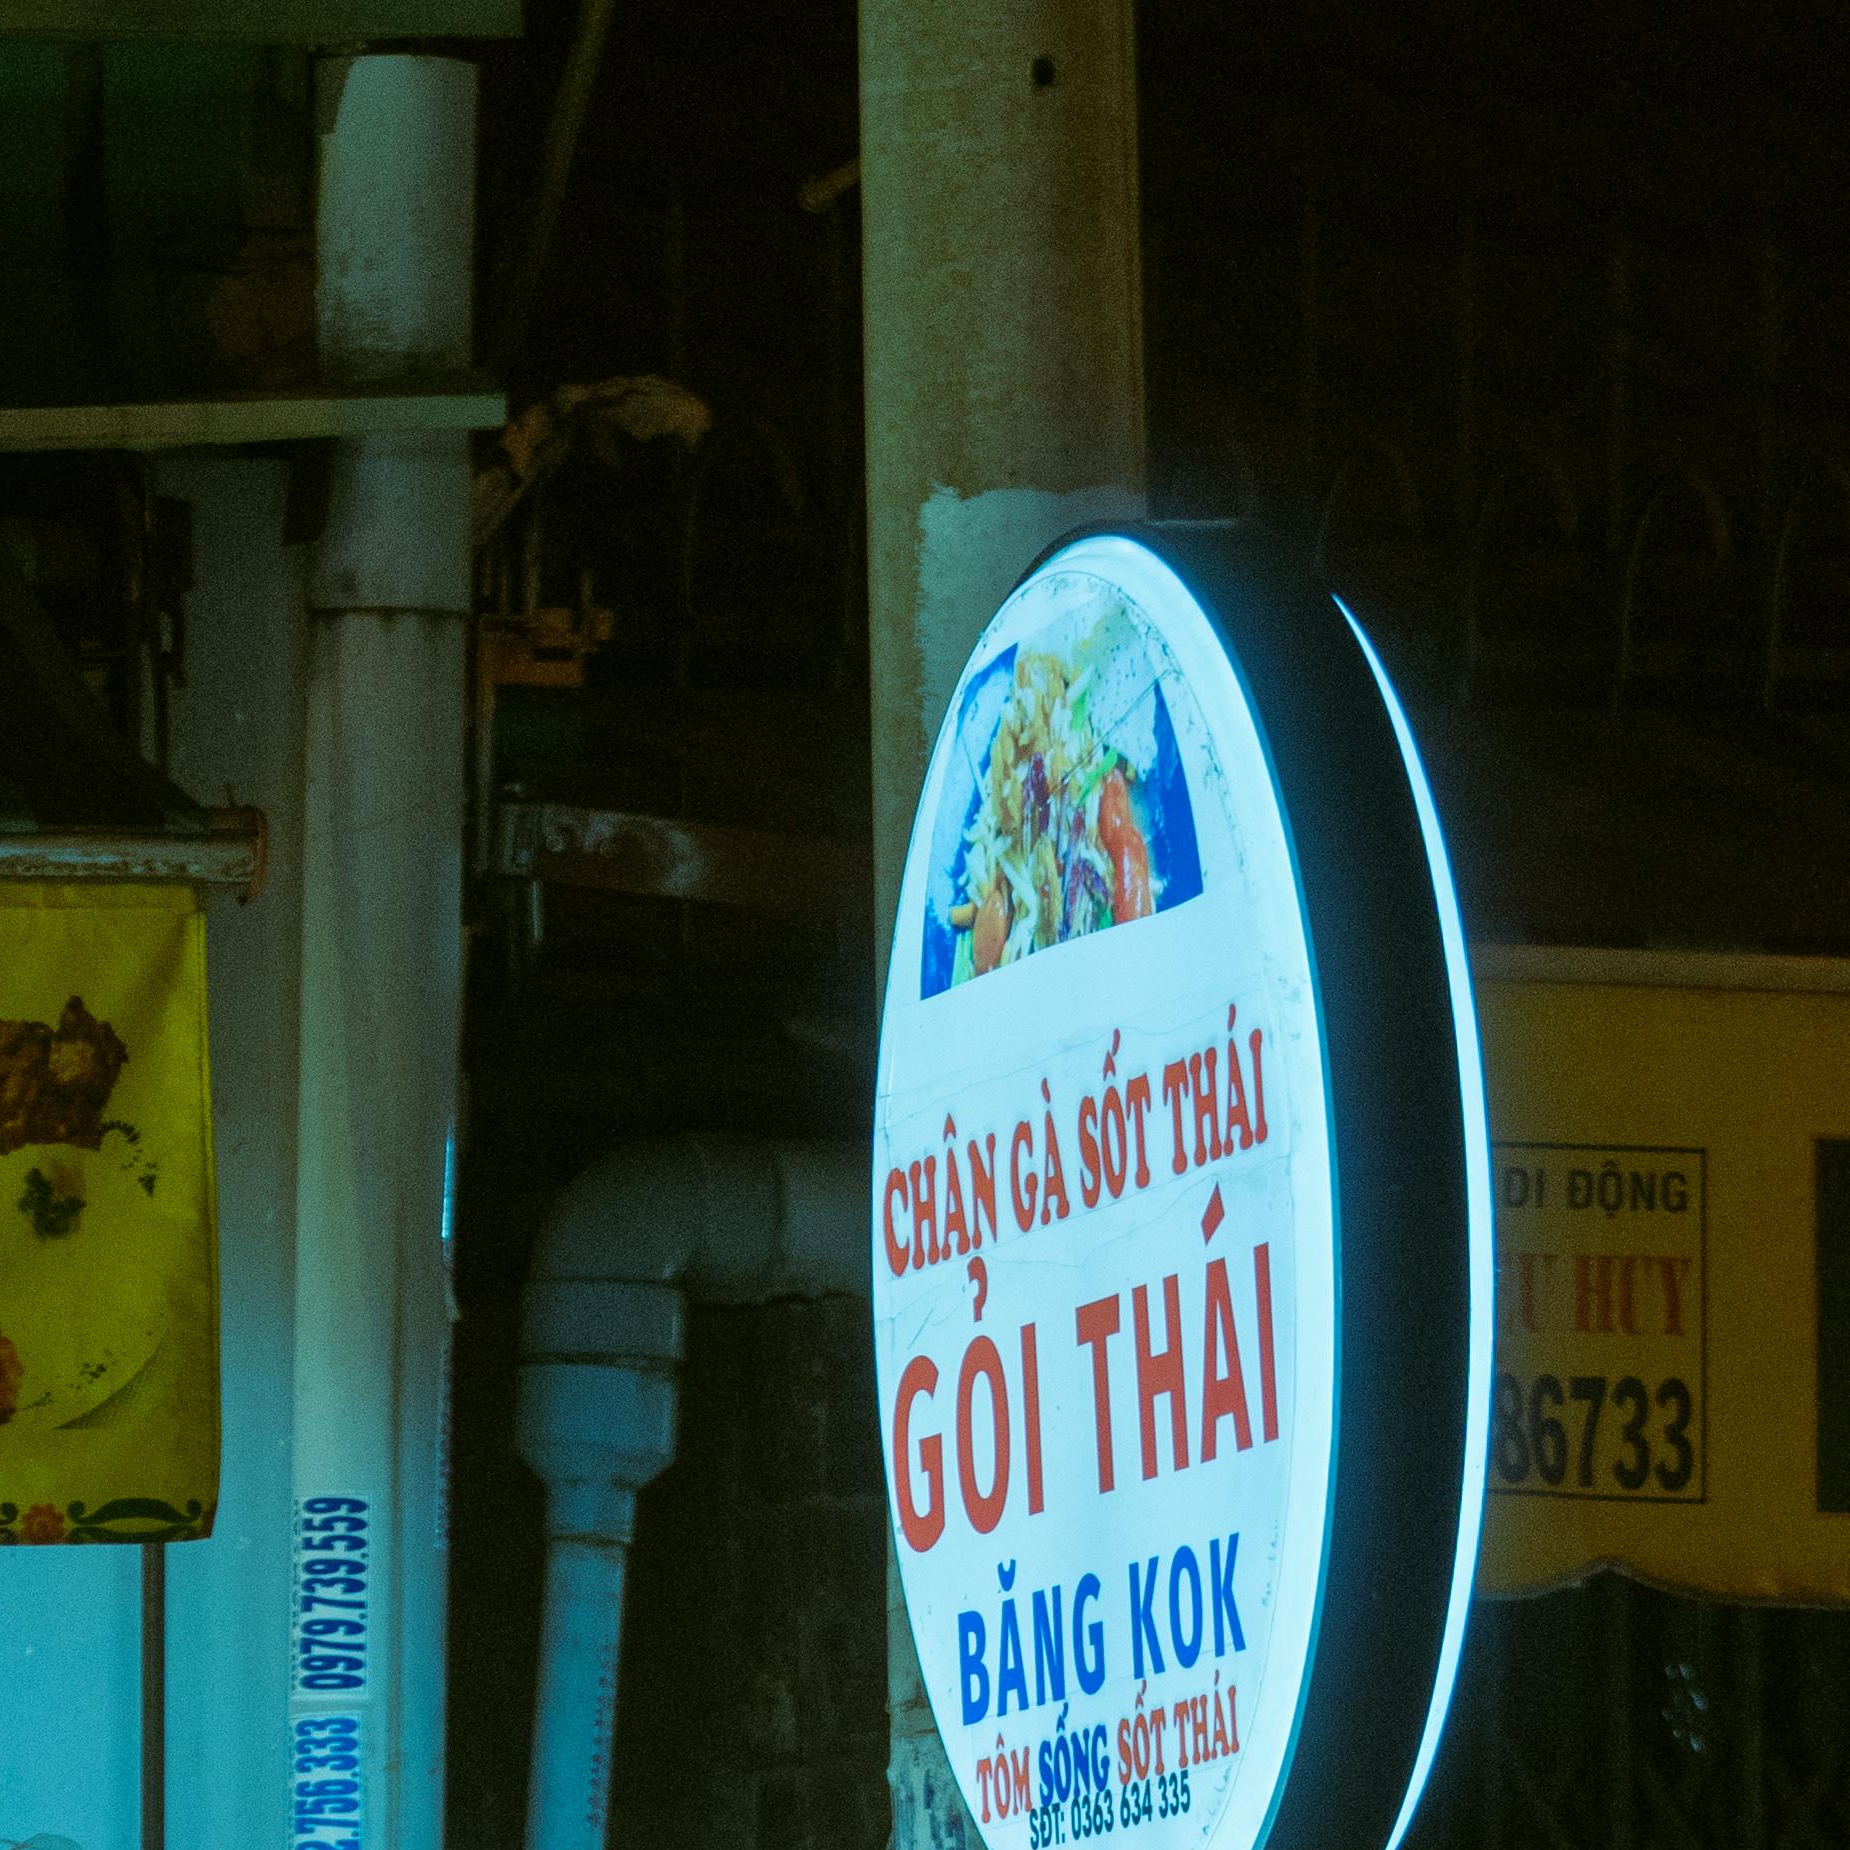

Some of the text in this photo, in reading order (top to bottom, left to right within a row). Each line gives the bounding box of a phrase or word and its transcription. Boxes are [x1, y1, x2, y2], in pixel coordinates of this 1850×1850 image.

[883, 1003, 1268, 1277] CHÂN GÀ SỐT THÁI
[1503, 1160, 1689, 1220] DI ĐỘNG
[893, 1181, 1280, 1552] GỎI THÁI
[299, 1497, 369, 1689] 0979.739.559
[957, 1532, 1246, 1727] BĂNG KOK
[976, 1732, 1032, 1824] TÔM
[1039, 1701, 1110, 1808] SỐNG
[1117, 1679, 1166, 1785] SỐT
[1174, 1669, 1240, 1769] THÁI
[1029, 1769, 1191, 1850] SĐT: 0363 634 335
